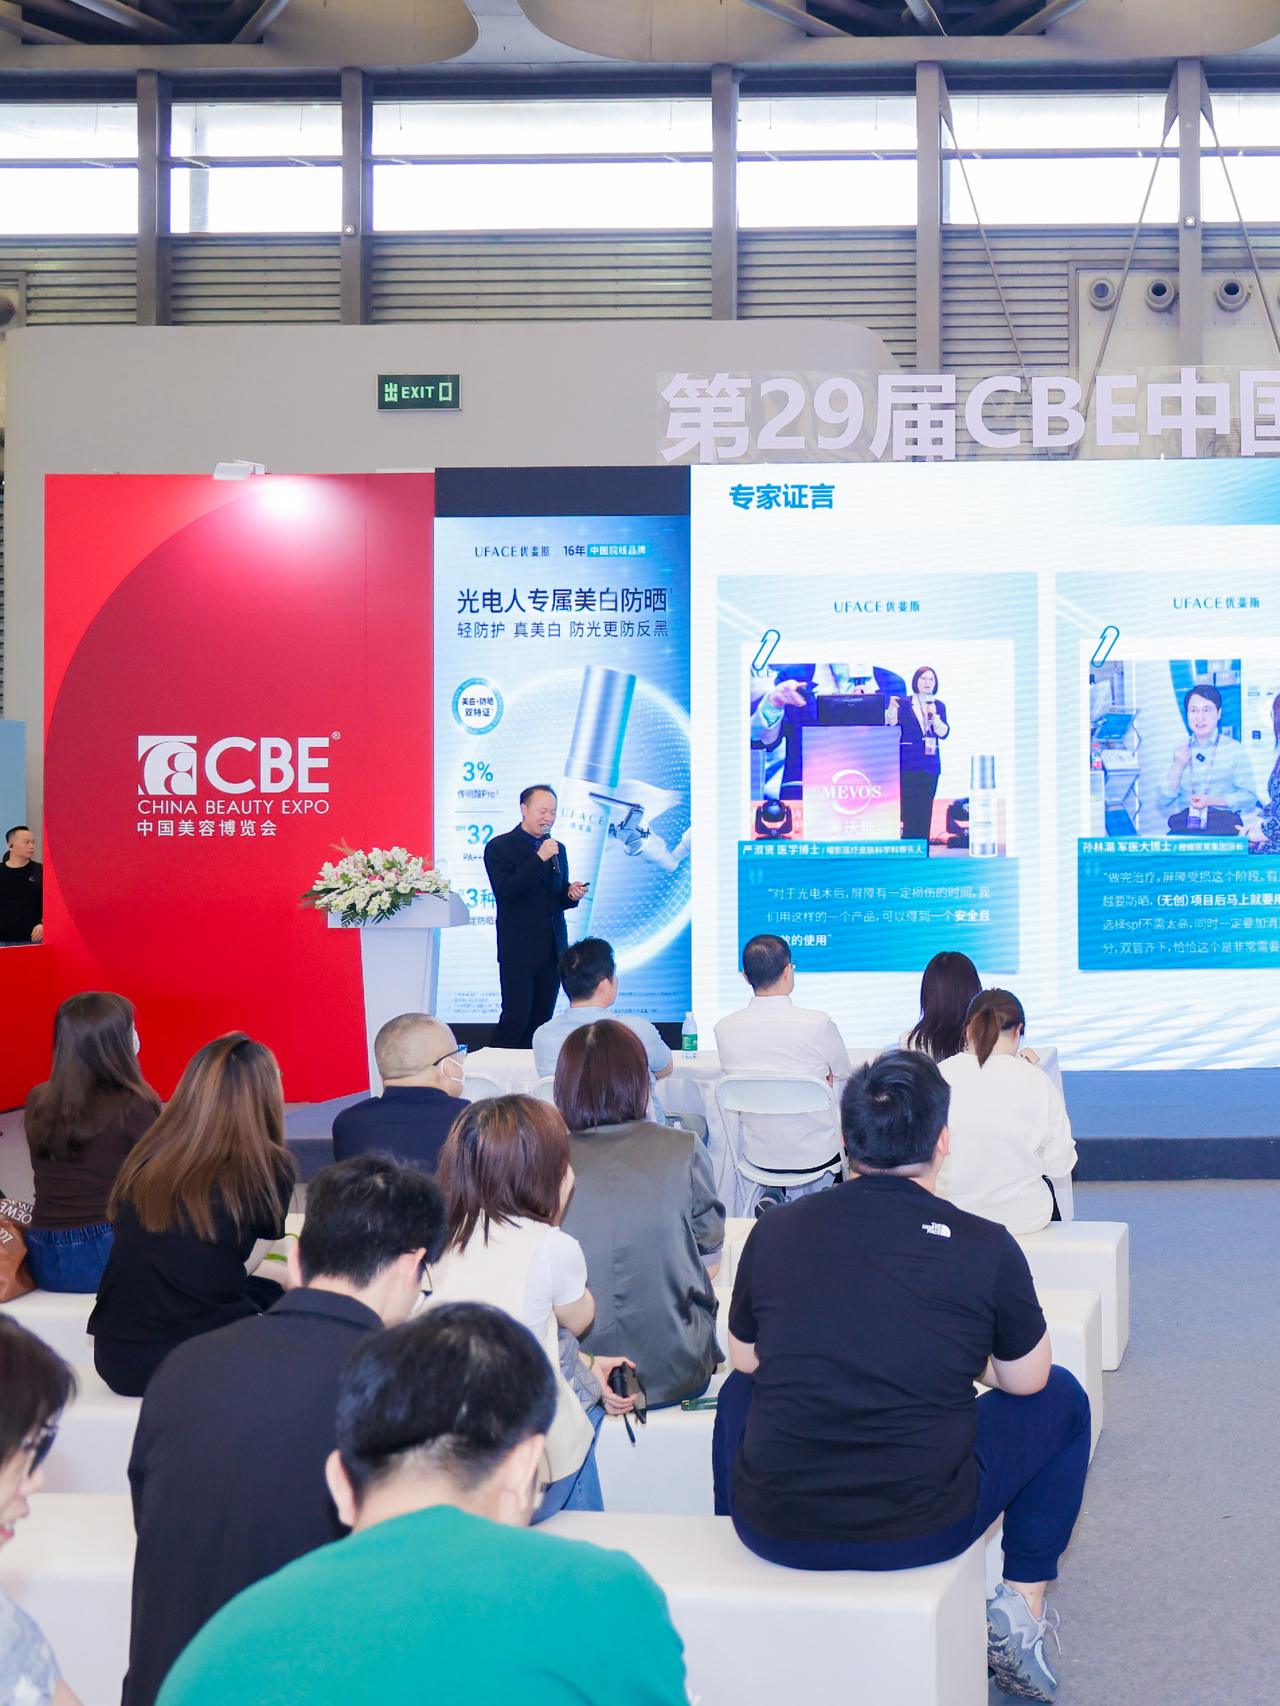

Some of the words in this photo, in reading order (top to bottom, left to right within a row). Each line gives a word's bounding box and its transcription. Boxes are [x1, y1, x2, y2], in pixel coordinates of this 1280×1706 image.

[384, 382, 398, 402] 出
[401, 386, 435, 399] EXIT
[438, 382, 452, 401] 口
[729, 483, 836, 510] 专家证言
[474, 546, 518, 558] UFACE
[563, 545, 586, 556] 16年
[457, 587, 668, 614] 光电人专属美白防晒
[834, 600, 883, 613] UFACE
[1173, 598, 1222, 609] UFACE
[457, 621, 506, 639] 轻防护
[513, 621, 562, 638] 真美白
[570, 620, 669, 638] 防光更防反黑
[463, 761, 494, 782] 3%
[823, 785, 882, 799] MEVOS
[137, 800, 198, 814] CHINA
[206, 800, 273, 814] BEAUTY
[282, 800, 329, 814] EXPO
[137, 820, 277, 837] 中国美容博览会
[467, 824, 495, 845] 32
